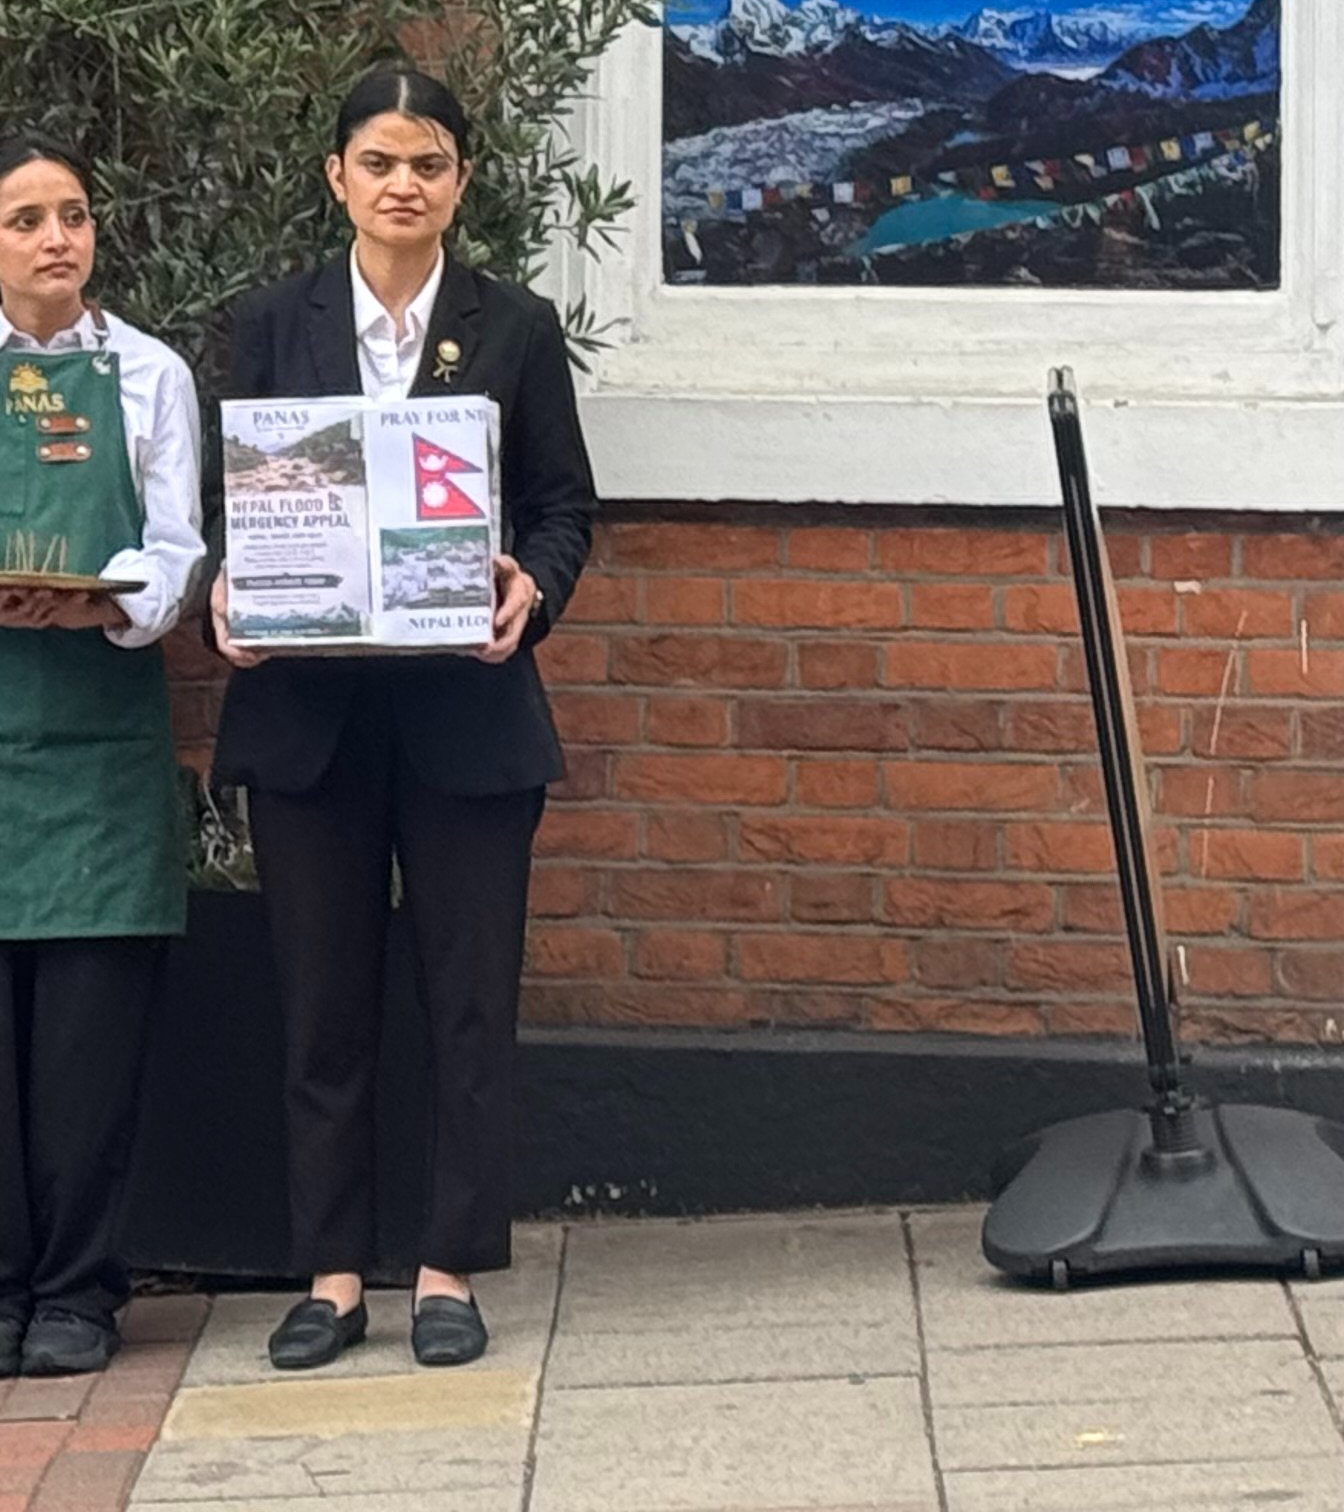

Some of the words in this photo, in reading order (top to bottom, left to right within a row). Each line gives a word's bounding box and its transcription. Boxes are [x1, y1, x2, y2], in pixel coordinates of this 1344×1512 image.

[5, 393, 66, 416] PANAS
[252, 410, 310, 425] PANAS
[380, 411, 421, 426] PRAY
[427, 410, 461, 424] FOR
[232, 498, 274, 513] NEPAL
[279, 498, 325, 513] FLOOD
[409, 616, 451, 629] NEPAL
